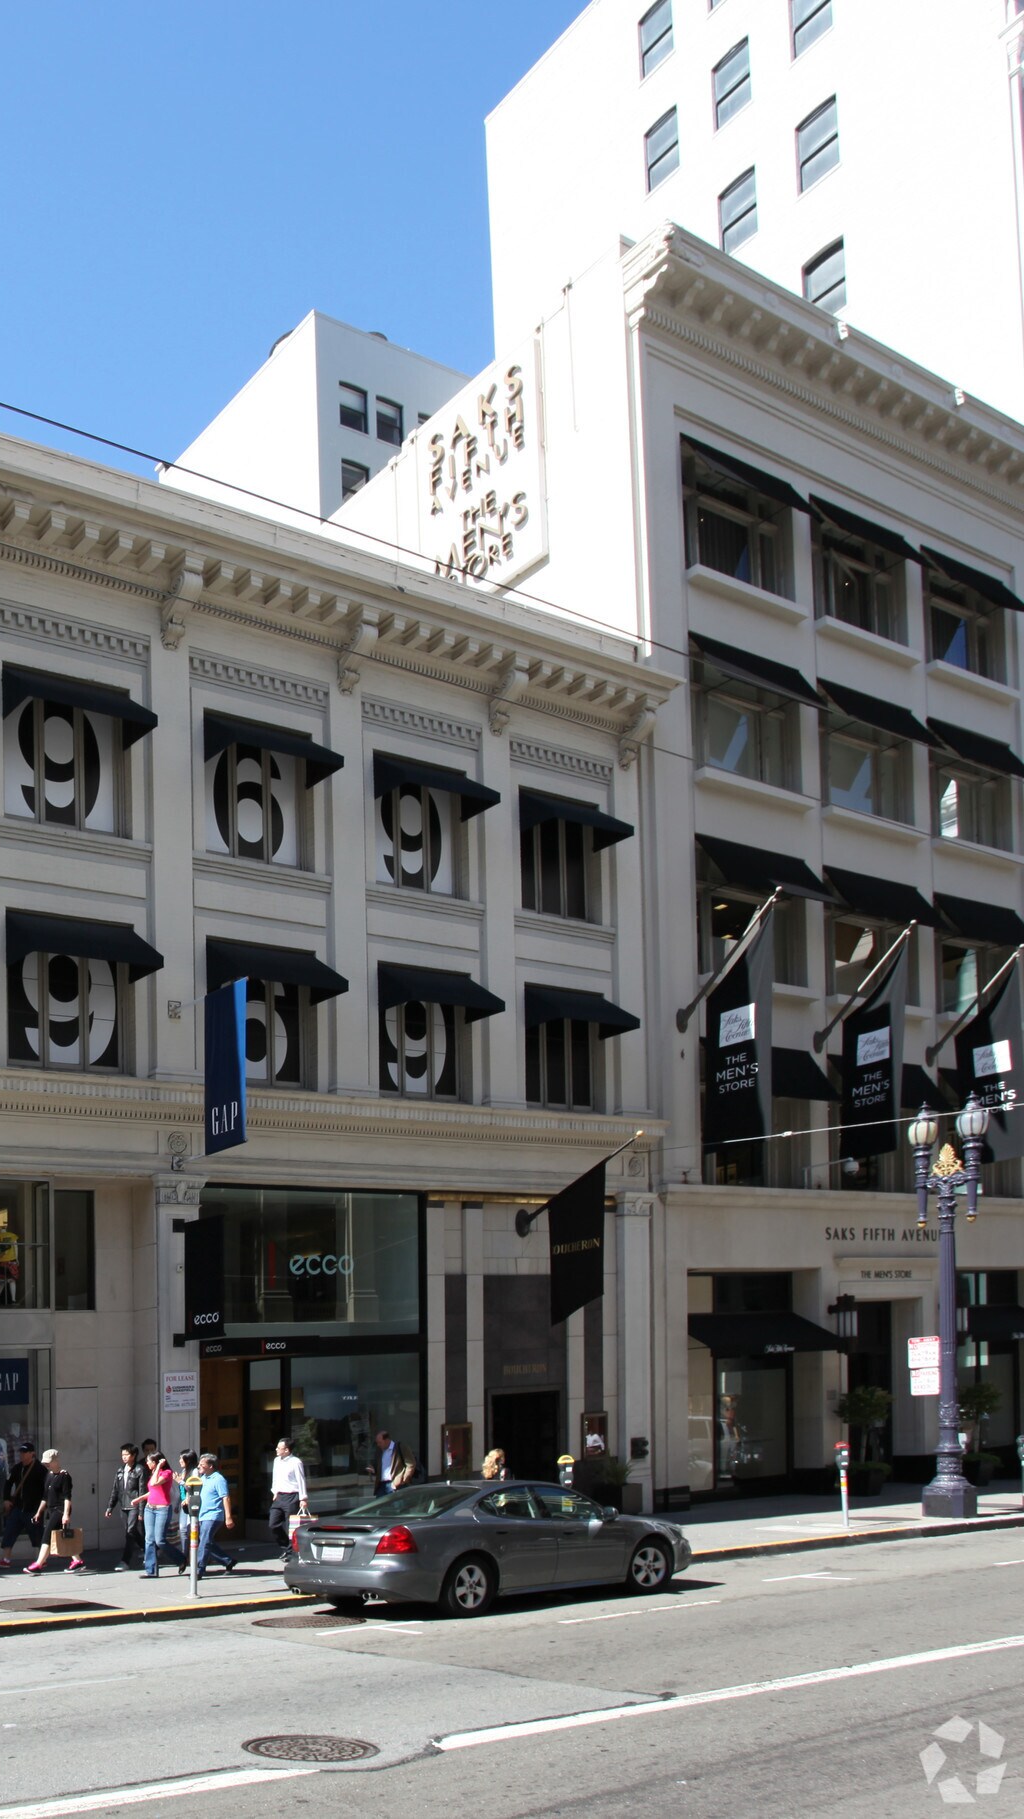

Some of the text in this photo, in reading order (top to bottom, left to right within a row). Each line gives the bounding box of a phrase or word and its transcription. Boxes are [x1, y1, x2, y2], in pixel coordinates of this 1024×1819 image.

[428, 365, 523, 467] SAKS
[430, 397, 524, 496] FIFTH
[431, 425, 525, 516] AVENUE
[460, 489, 497, 532] THE
[436, 491, 528, 579] MEN'S
[725, 1053, 747, 1066] THE
[716, 1063, 759, 1082] MEN'S
[863, 1070, 883, 1083] THE
[719, 1078, 756, 1094] STORE
[852, 1079, 890, 1097] MEN'S
[984, 1081, 1006, 1093] THE
[854, 1092, 887, 1108] STORE
[211, 1100, 239, 1138] GAP
[825, 1226, 856, 1241] SAKS
[863, 1227, 895, 1241] FIFTH
[552, 1237, 601, 1255] OUCHERON
[289, 1254, 354, 1276] ecco
[860, 1269, 913, 1279] THE MEN'S STORE
[193, 1312, 220, 1325] ecco
[205, 1345, 223, 1353] ecco
[265, 1342, 287, 1350] ecco
[178, 1374, 194, 1382] LEASE
